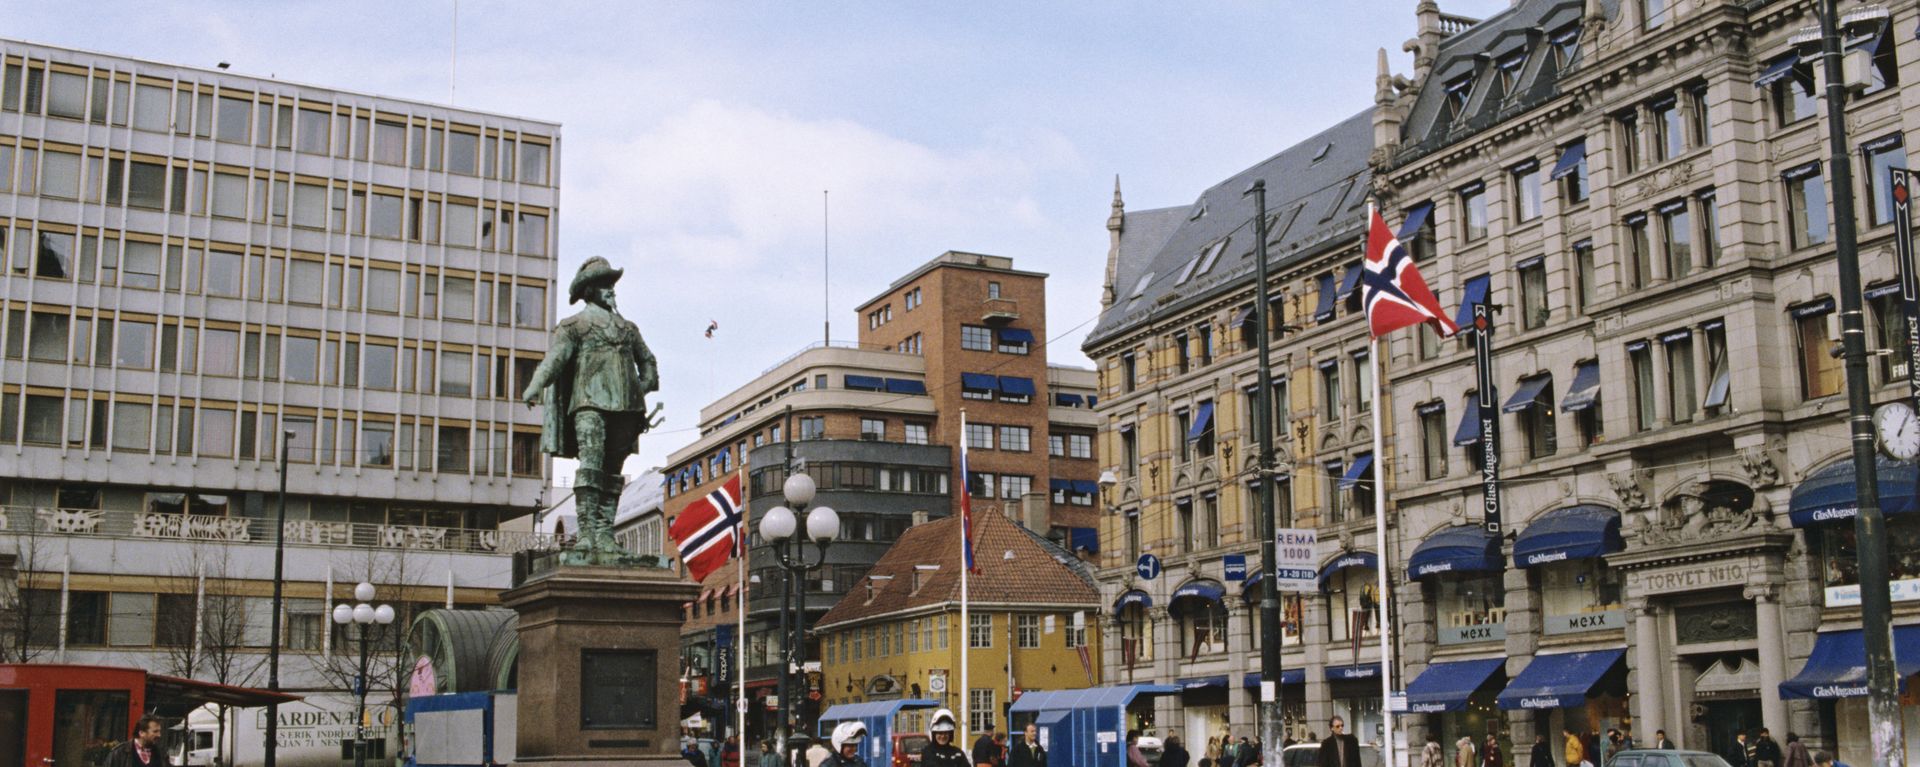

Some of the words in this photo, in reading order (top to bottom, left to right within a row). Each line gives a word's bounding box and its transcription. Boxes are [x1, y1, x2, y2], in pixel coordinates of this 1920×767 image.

[1482, 419, 1498, 514] GlasMagasinet
[1813, 506, 1859, 521] GlasMagasin
[1277, 534, 1316, 545] REMA
[1283, 548, 1311, 560] 1000
[1646, 570, 1705, 590] TORVET
[1813, 684, 1869, 698] GlasMagasinet
